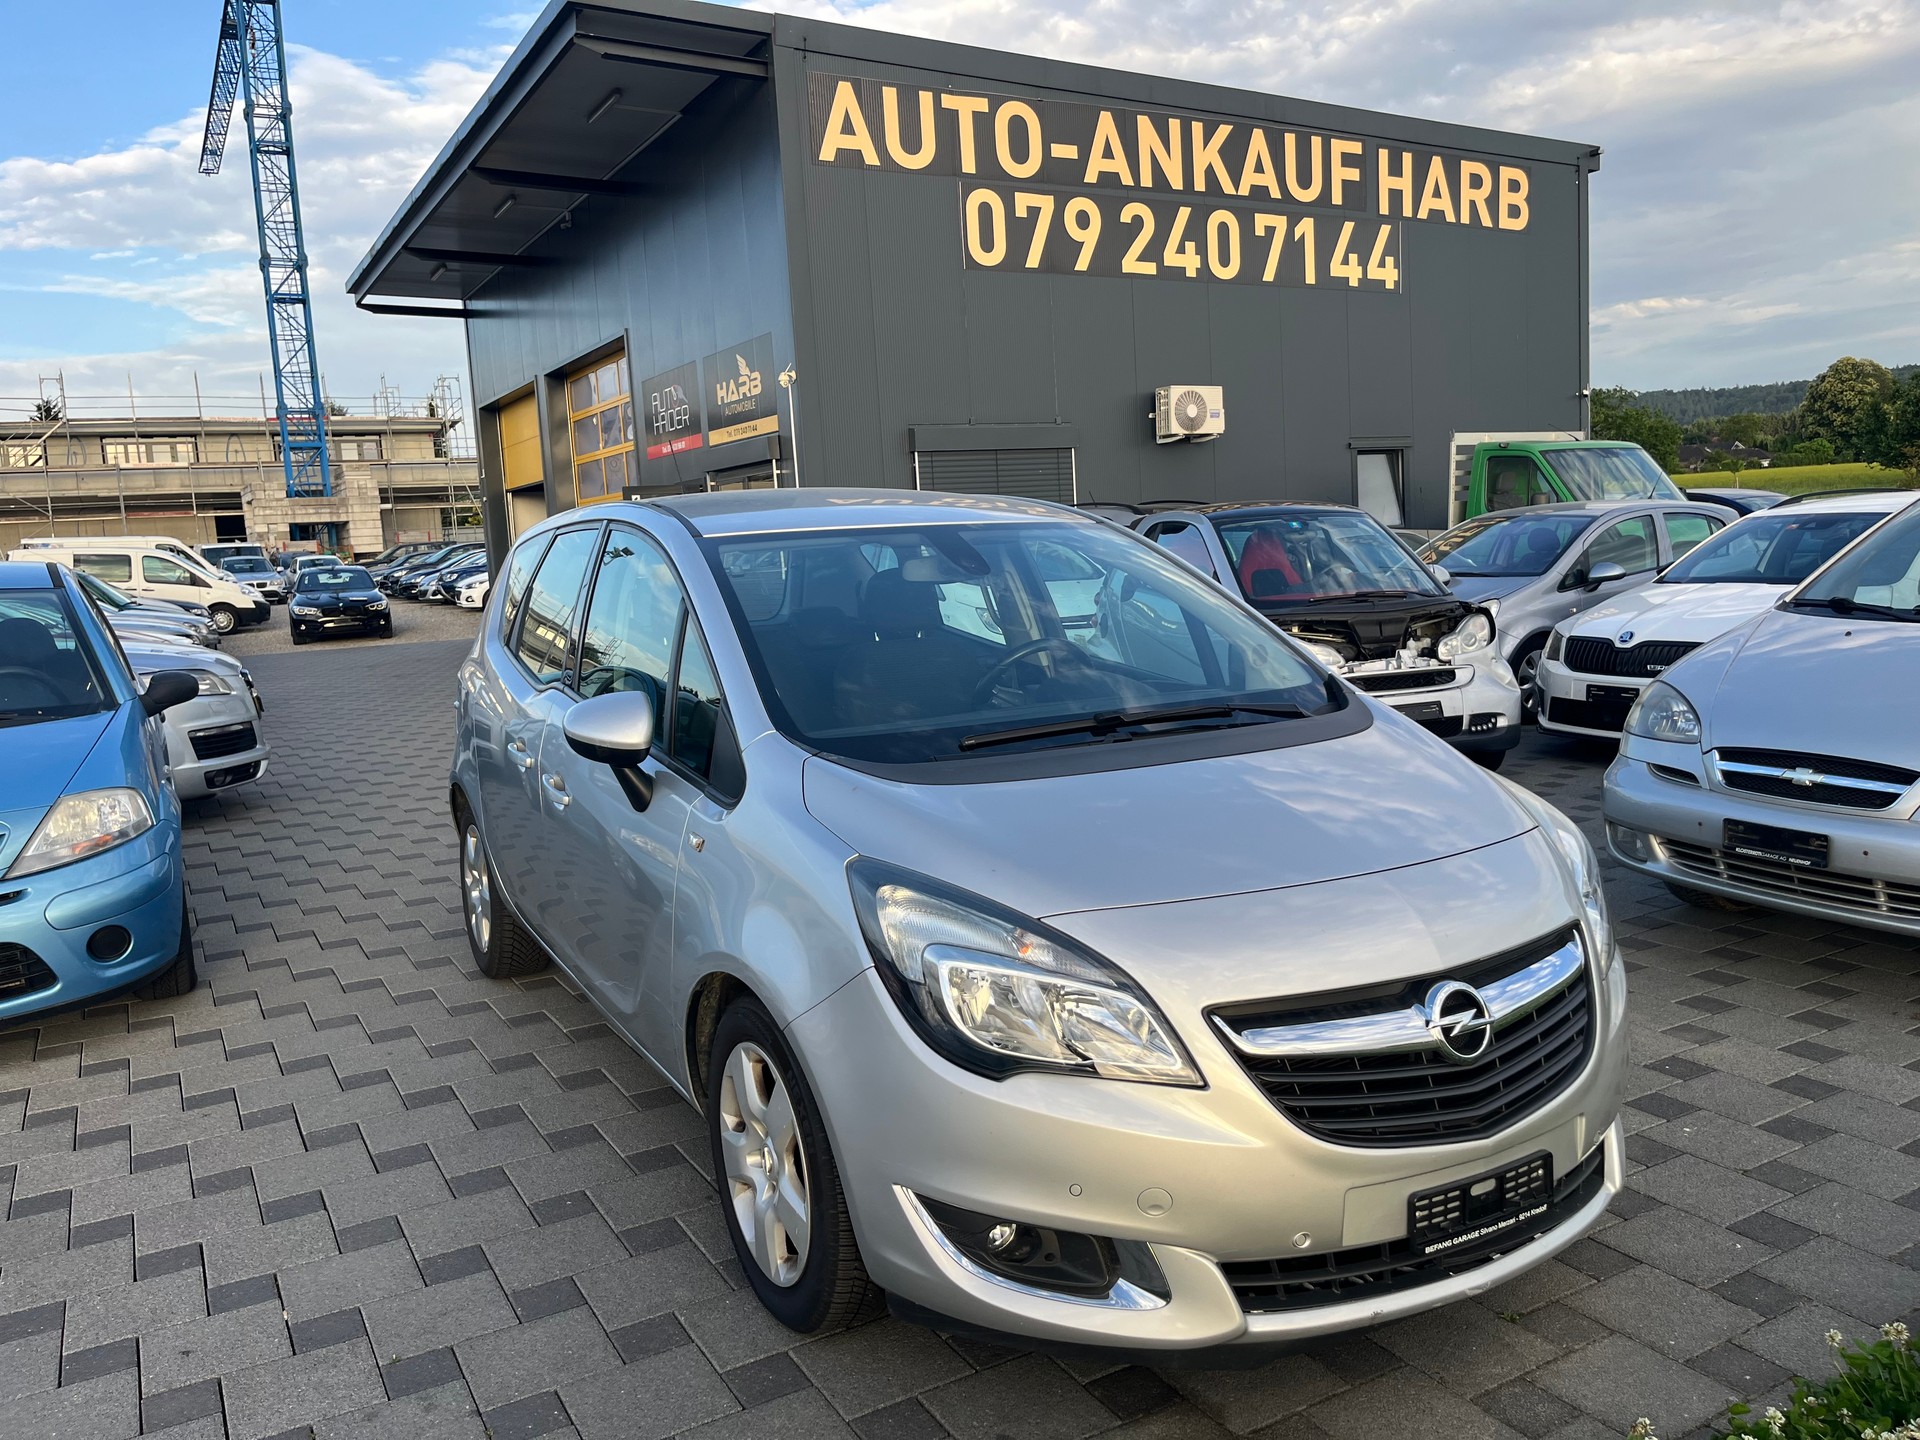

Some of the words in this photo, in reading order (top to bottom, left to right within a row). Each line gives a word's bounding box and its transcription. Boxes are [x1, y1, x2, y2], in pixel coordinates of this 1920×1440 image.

[819, 80, 1363, 205] AUTO-ANKAUF
[1378, 148, 1529, 231] HARB
[965, 188, 1102, 271] 079
[1120, 202, 1241, 280] 240
[1254, 213, 1316, 285] 71
[1329, 221, 1399, 289] 44
[716, 371, 762, 405] HARB
[725, 398, 756, 416] AUTOMOBILE
[1453, 1230, 1480, 1245] GARAGE
